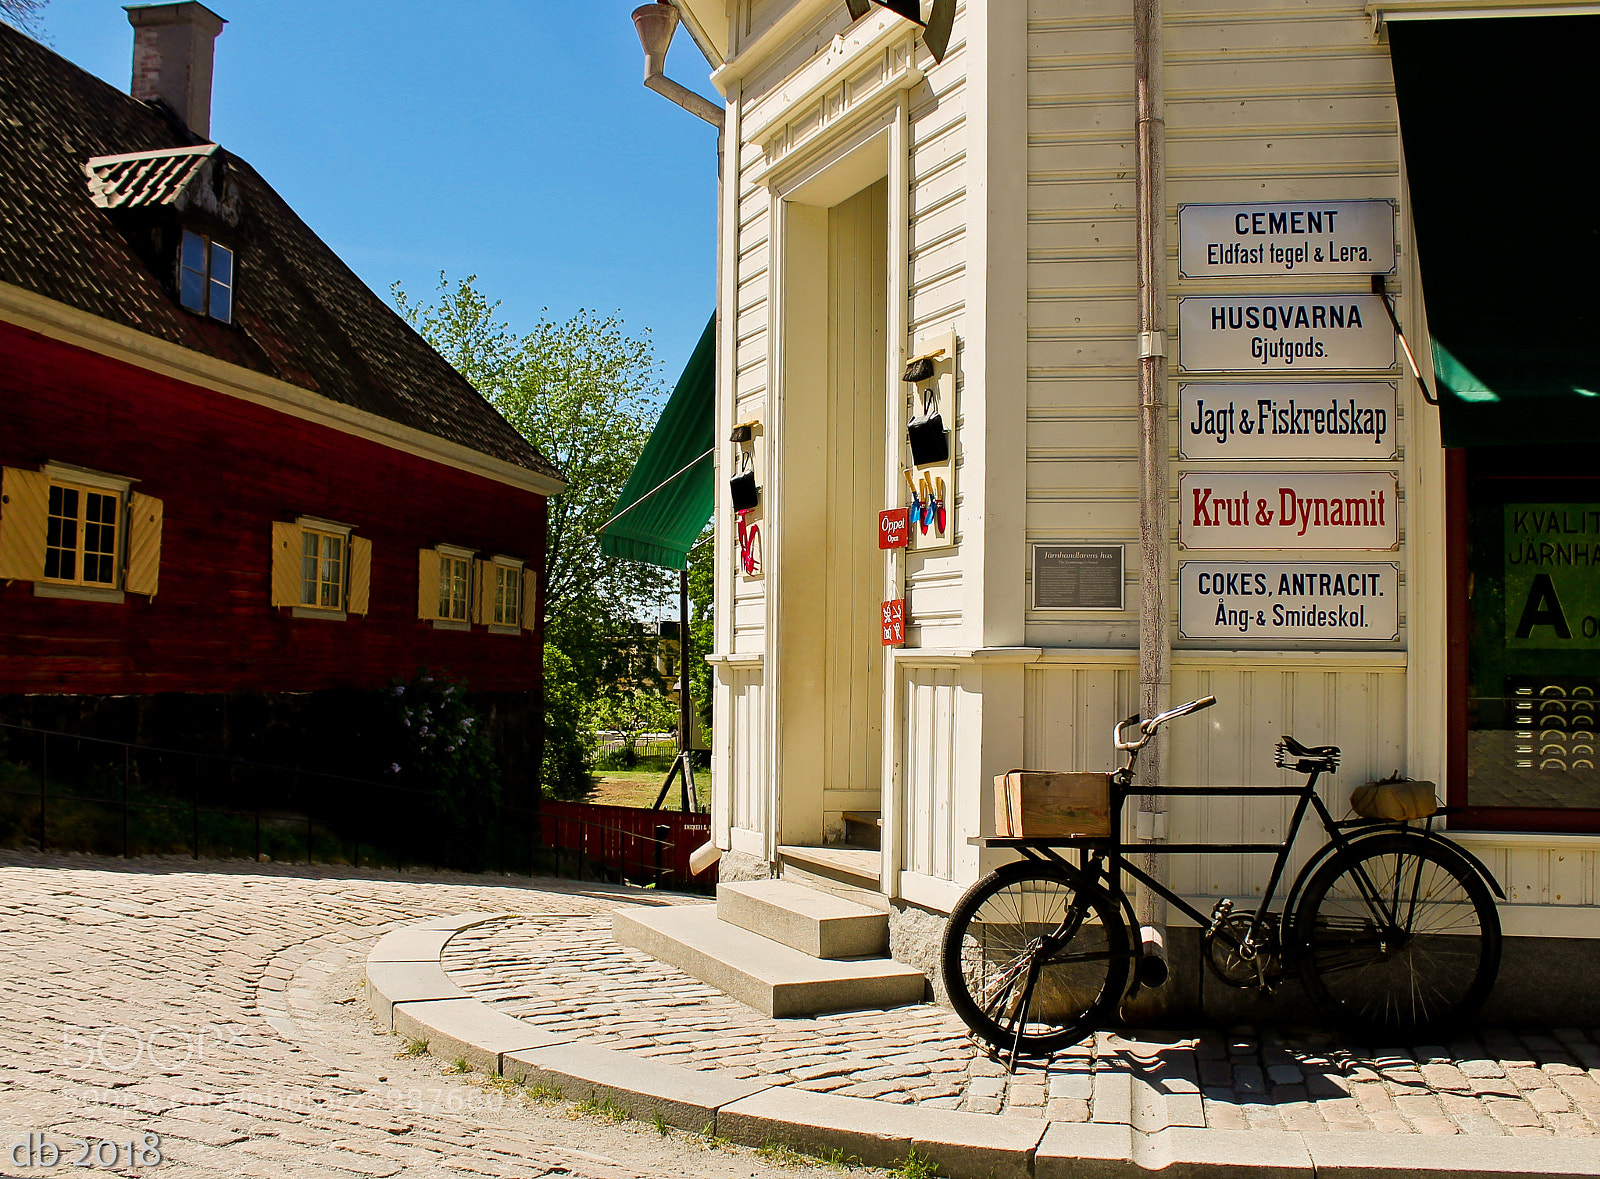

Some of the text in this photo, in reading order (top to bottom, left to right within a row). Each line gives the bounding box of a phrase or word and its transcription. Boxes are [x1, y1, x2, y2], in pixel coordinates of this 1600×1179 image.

[1235, 210, 1338, 235] CEMENT
[1207, 241, 1373, 269] Eldfast tegel & Lera.
[1211, 305, 1363, 331] HUSQVARNA
[1251, 336, 1328, 365] Gjutgods.
[1190, 399, 1387, 444] Jagt & Fiskredskap
[1192, 488, 1385, 536] Krut & Dynamit
[1198, 572, 1384, 597] COKES, ANTRACIT.
[1272, 603, 1369, 628] Smideskol.
[1515, 574, 1600, 639] A O
